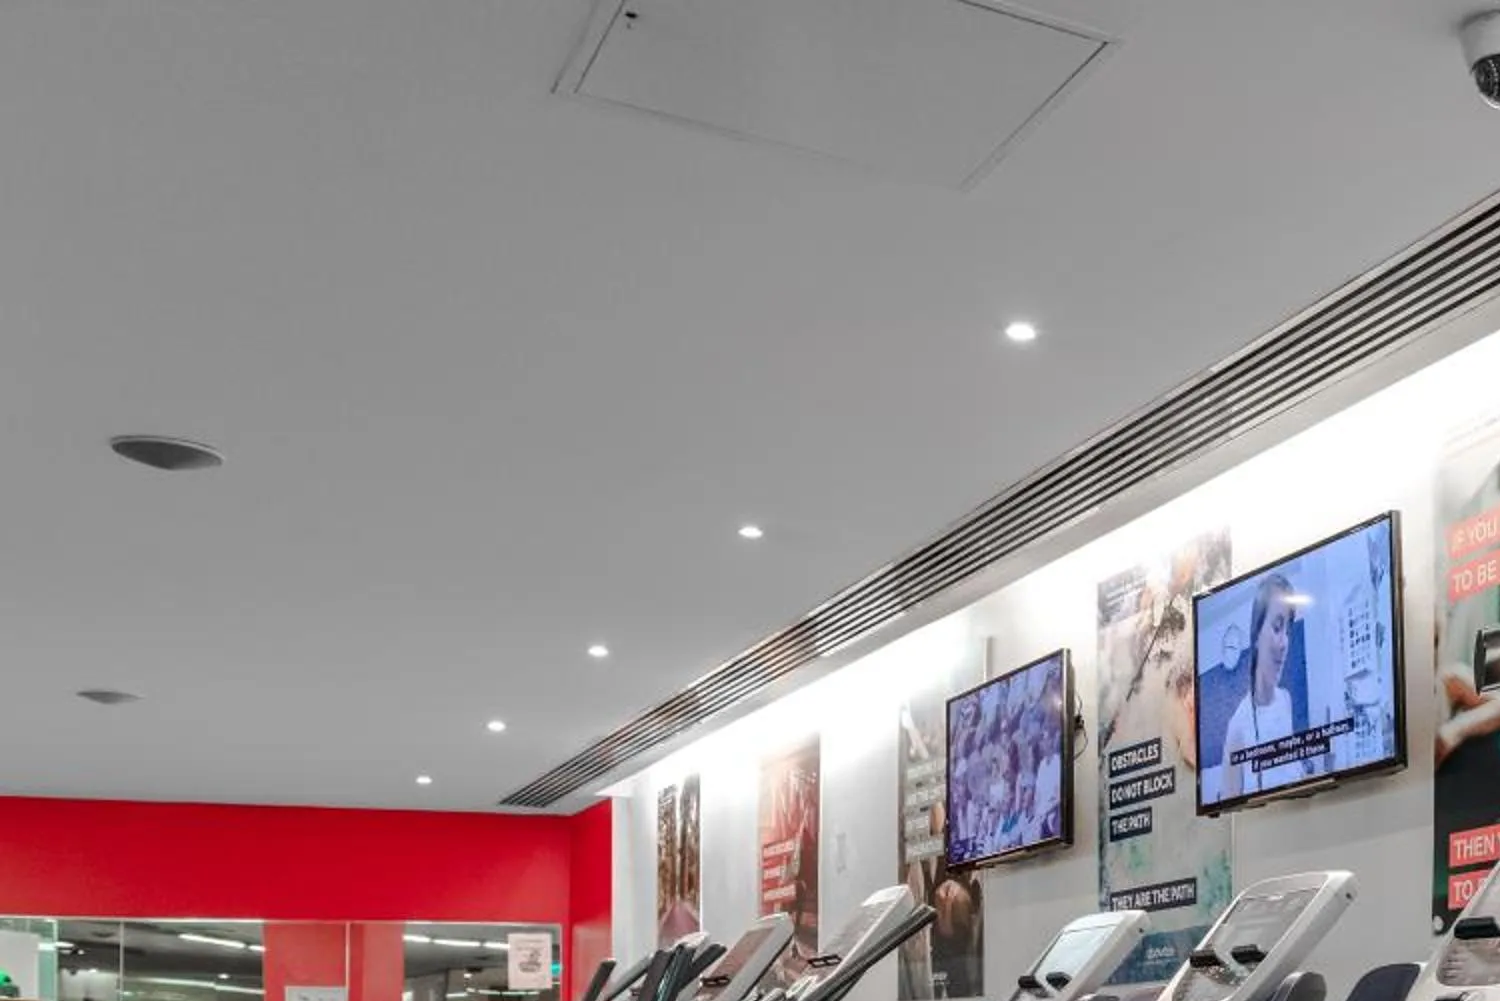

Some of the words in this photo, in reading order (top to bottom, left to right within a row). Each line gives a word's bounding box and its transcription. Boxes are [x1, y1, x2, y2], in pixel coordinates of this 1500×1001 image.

[1468, 519, 1498, 545] YOU
[1453, 569, 1474, 593] TO
[1477, 559, 1498, 585] BE
[1111, 743, 1159, 771] OBSTACLES
[1110, 787, 1124, 803] DO
[1124, 782, 1142, 799] NOT
[1143, 771, 1173, 795] BLOCK
[1111, 818, 1127, 835] THE
[1127, 813, 1151, 831] PATH
[1453, 831, 1495, 860] THEN
[1134, 889, 1151, 906] ARE
[1151, 884, 1171, 903] THE
[1171, 881, 1195, 901] PATH
[1453, 879, 1473, 902] TO
